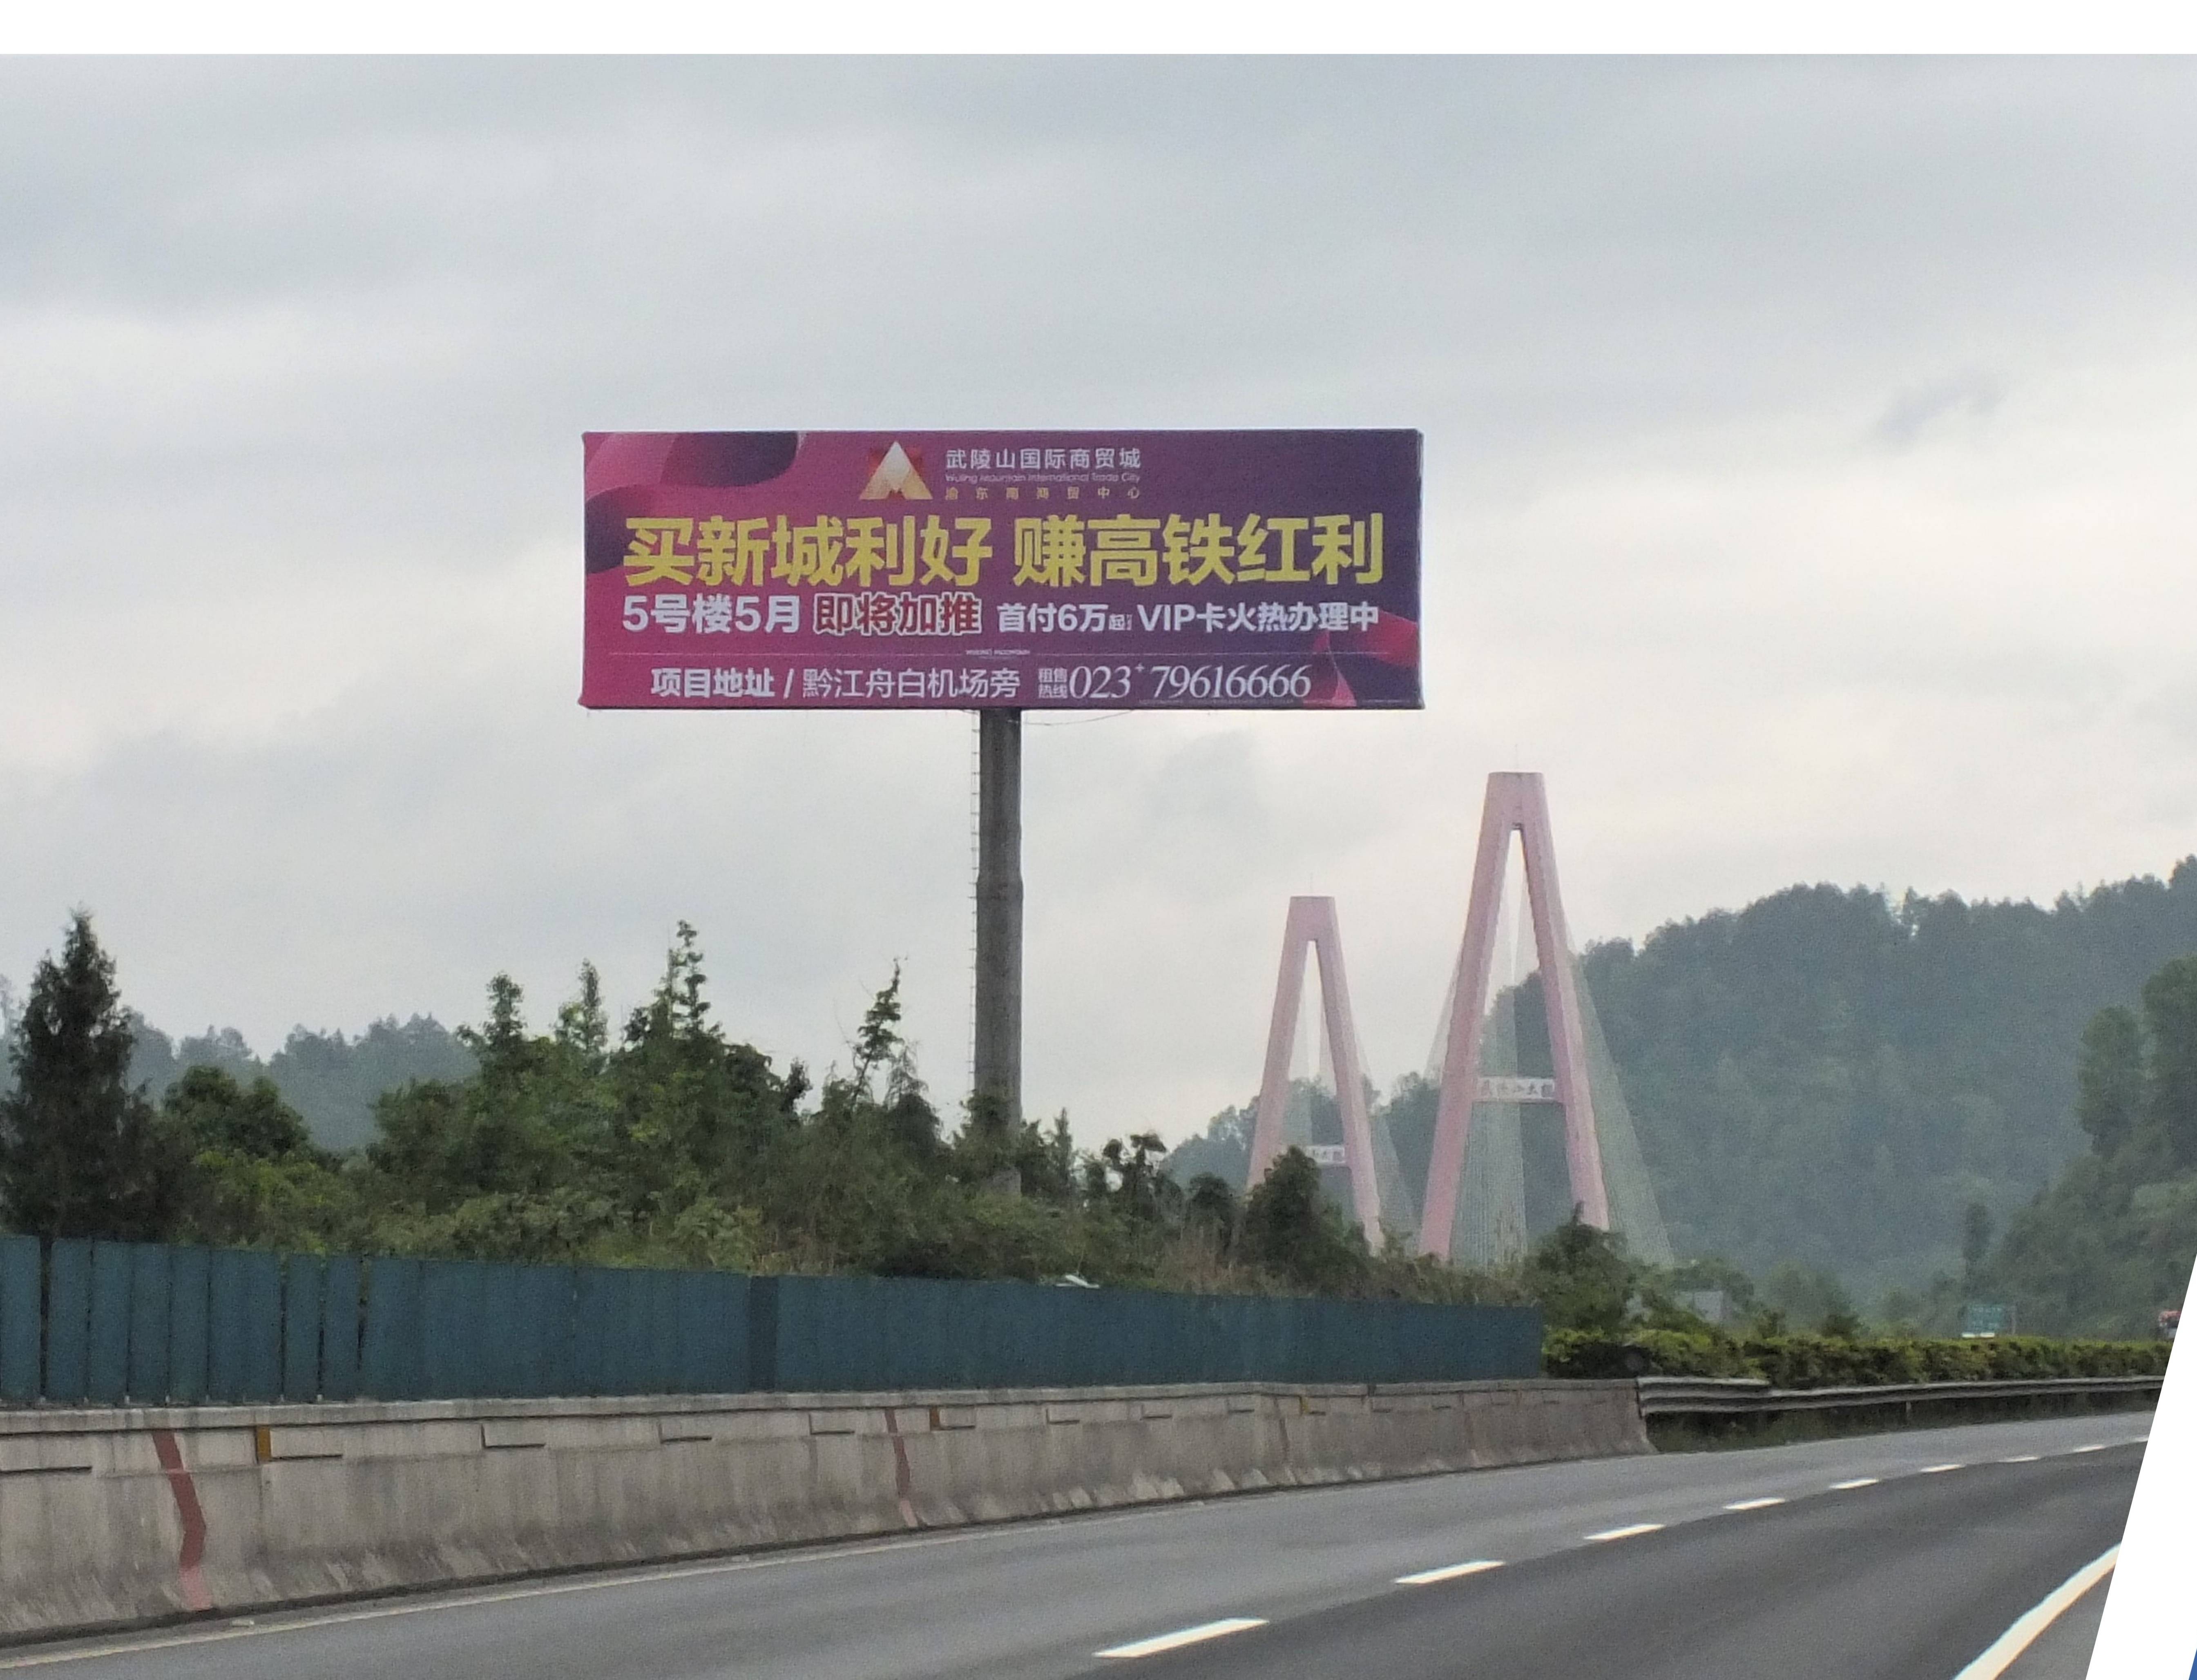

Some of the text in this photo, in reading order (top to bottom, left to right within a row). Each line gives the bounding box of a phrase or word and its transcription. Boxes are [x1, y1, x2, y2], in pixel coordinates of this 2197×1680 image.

[946, 448, 1141, 470] 武陵山国际商贸城
[623, 513, 1383, 587] 买新城利好 赚高铁红利
[623, 593, 800, 634] 5号楼5月
[813, 591, 982, 636] 即将加推
[1137, 601, 1379, 633] VIP卡火热办理中
[803, 667, 1020, 698] 黔江舟白机场旁
